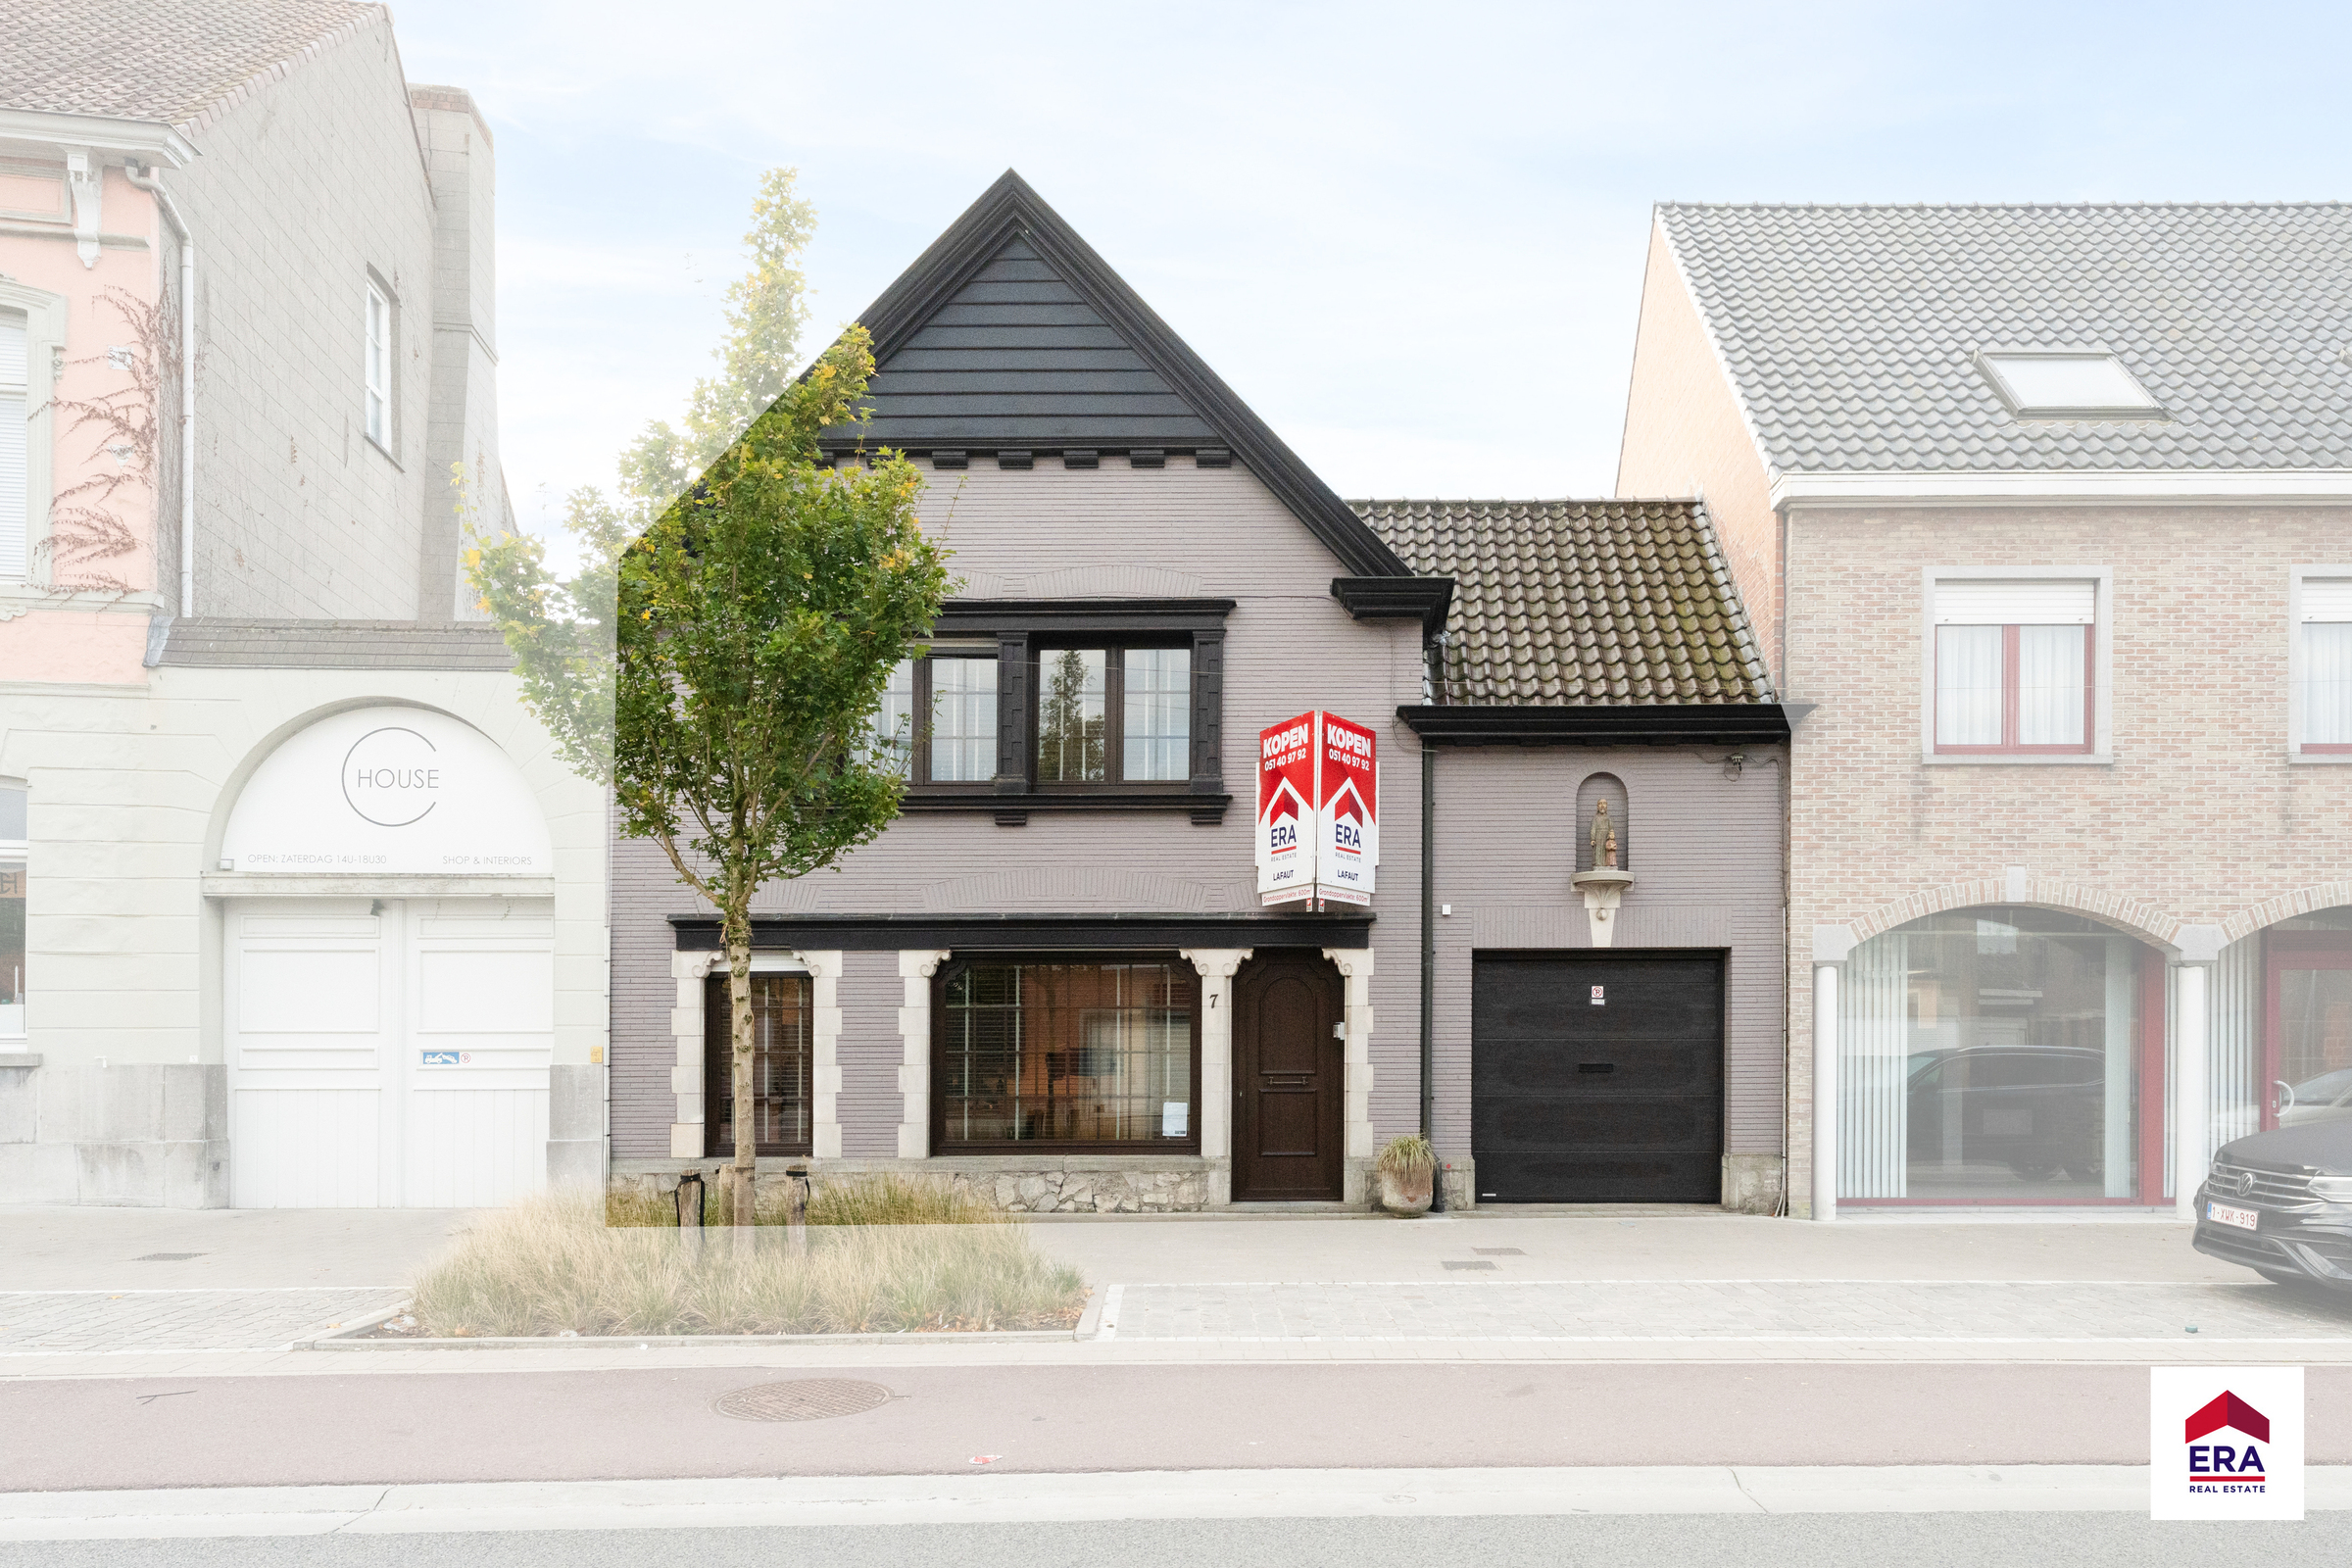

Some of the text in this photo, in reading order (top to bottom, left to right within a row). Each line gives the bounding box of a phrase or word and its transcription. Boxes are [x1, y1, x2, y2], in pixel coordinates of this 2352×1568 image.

[1263, 723, 1308, 759] KOPEN
[1327, 723, 1371, 758] KOPEN
[1264, 748, 1306, 771] 051 40 97 92
[1328, 748, 1370, 771] 051 40 97 92
[358, 768, 439, 789] HOUSE
[1271, 824, 1297, 848] ERA
[1336, 823, 1361, 848] ERA
[247, 854, 387, 863] OPEN: ZATERDAG 14U-18U30
[442, 856, 532, 865] SHOP & INTERIORS
[1282, 852, 1298, 860] ESTATE
[1346, 854, 1361, 863] ESTATE
[1273, 869, 1294, 881] LAFAUT
[1337, 868, 1358, 882] LAFAUT
[1209, 994, 1219, 1009] 7
